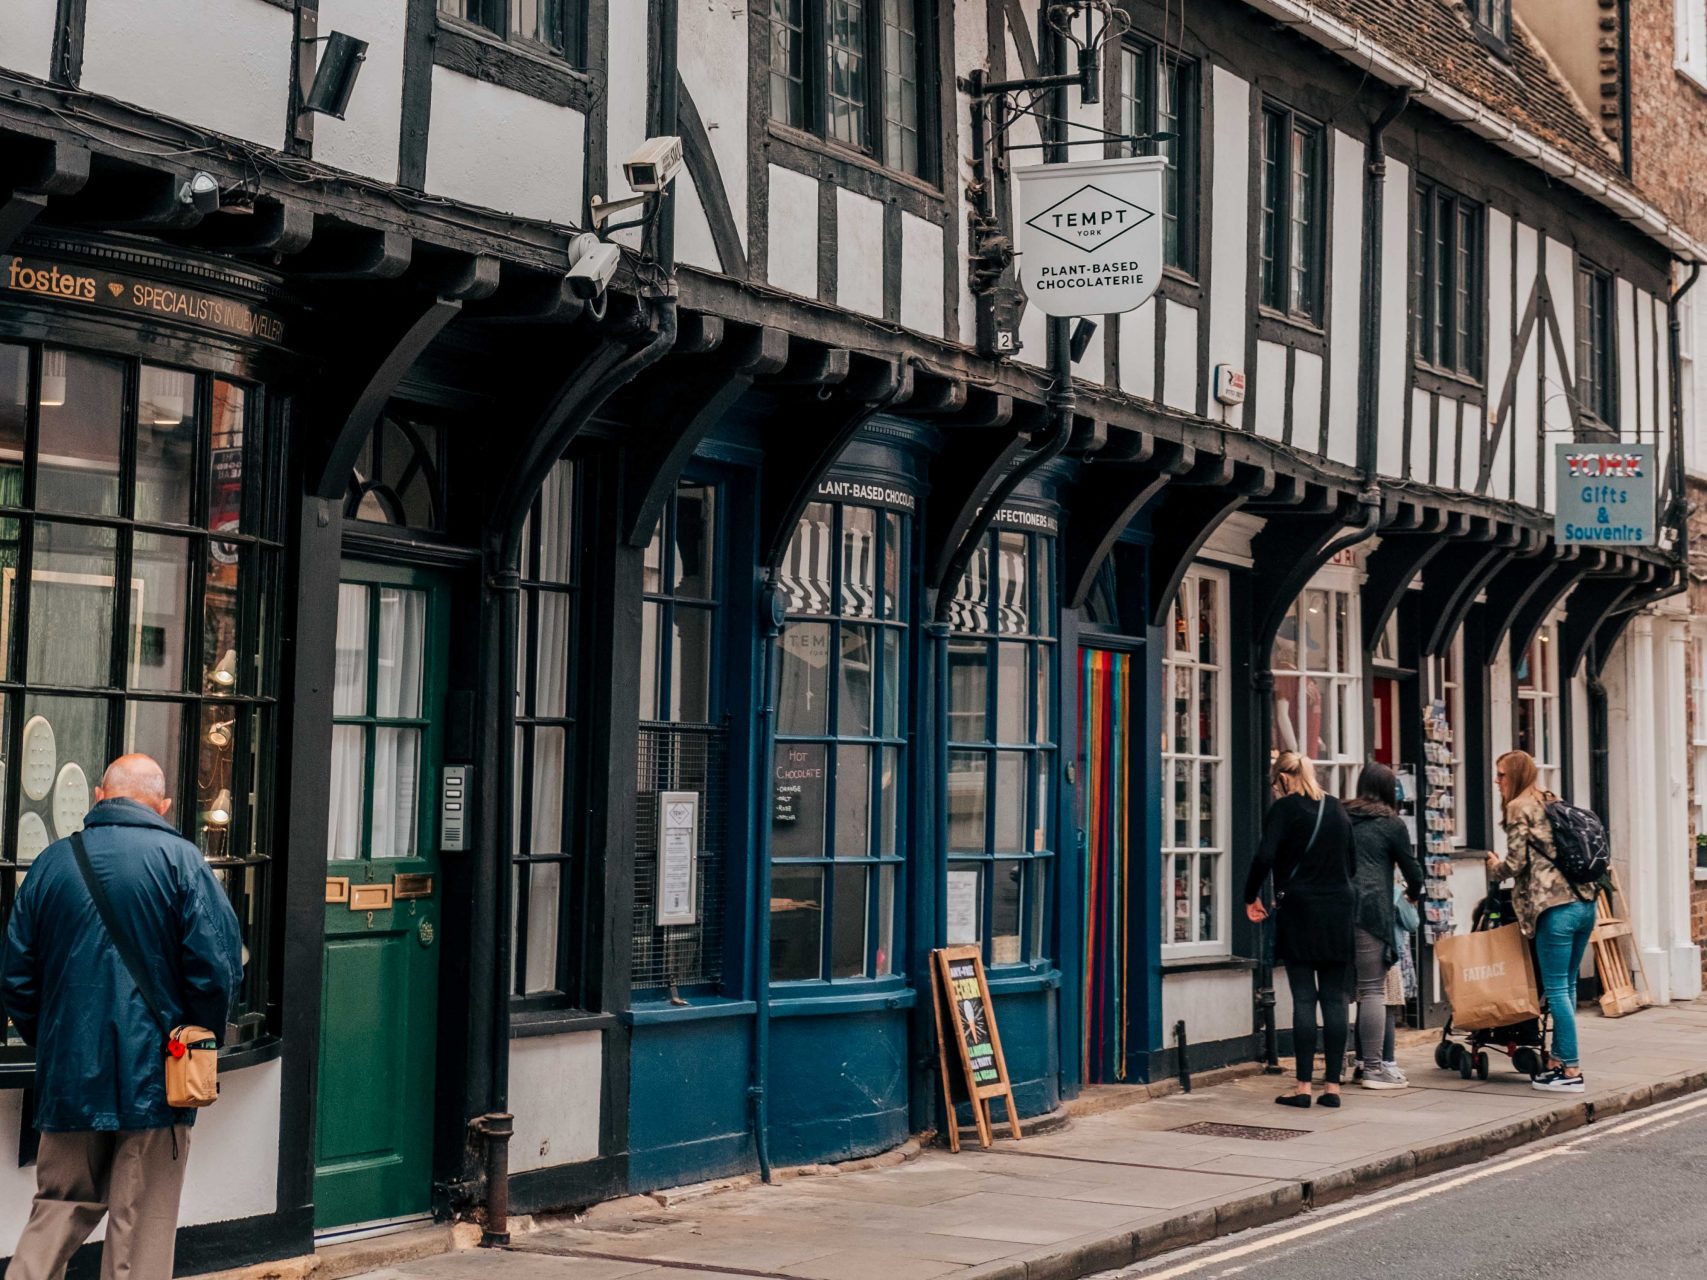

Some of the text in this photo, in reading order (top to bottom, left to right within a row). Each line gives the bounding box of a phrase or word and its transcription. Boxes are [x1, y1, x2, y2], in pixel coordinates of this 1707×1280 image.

[1052, 209, 1127, 228] TEMPT
[1077, 229, 1102, 237] YORK
[1041, 261, 1139, 277] PLANT-BASED
[1036, 274, 1144, 290] CHOCOLATERIE
[8, 257, 97, 300] fosters
[133, 283, 223, 325] SPECIALISTS
[223, 305, 236, 327] IN
[1001, 334, 1010, 348] 2
[1565, 453, 1644, 478] YORK
[818, 481, 884, 501] LANT-BASED
[1581, 485, 1628, 503] Gifts
[976, 507, 1047, 528] CNFECTIONERS
[1597, 506, 1610, 524] &
[1565, 523, 1643, 541] Souvenirs
[789, 634, 849, 647] TEMT
[789, 750, 809, 762] HOT
[776, 766, 822, 779] CHOCOLATE
